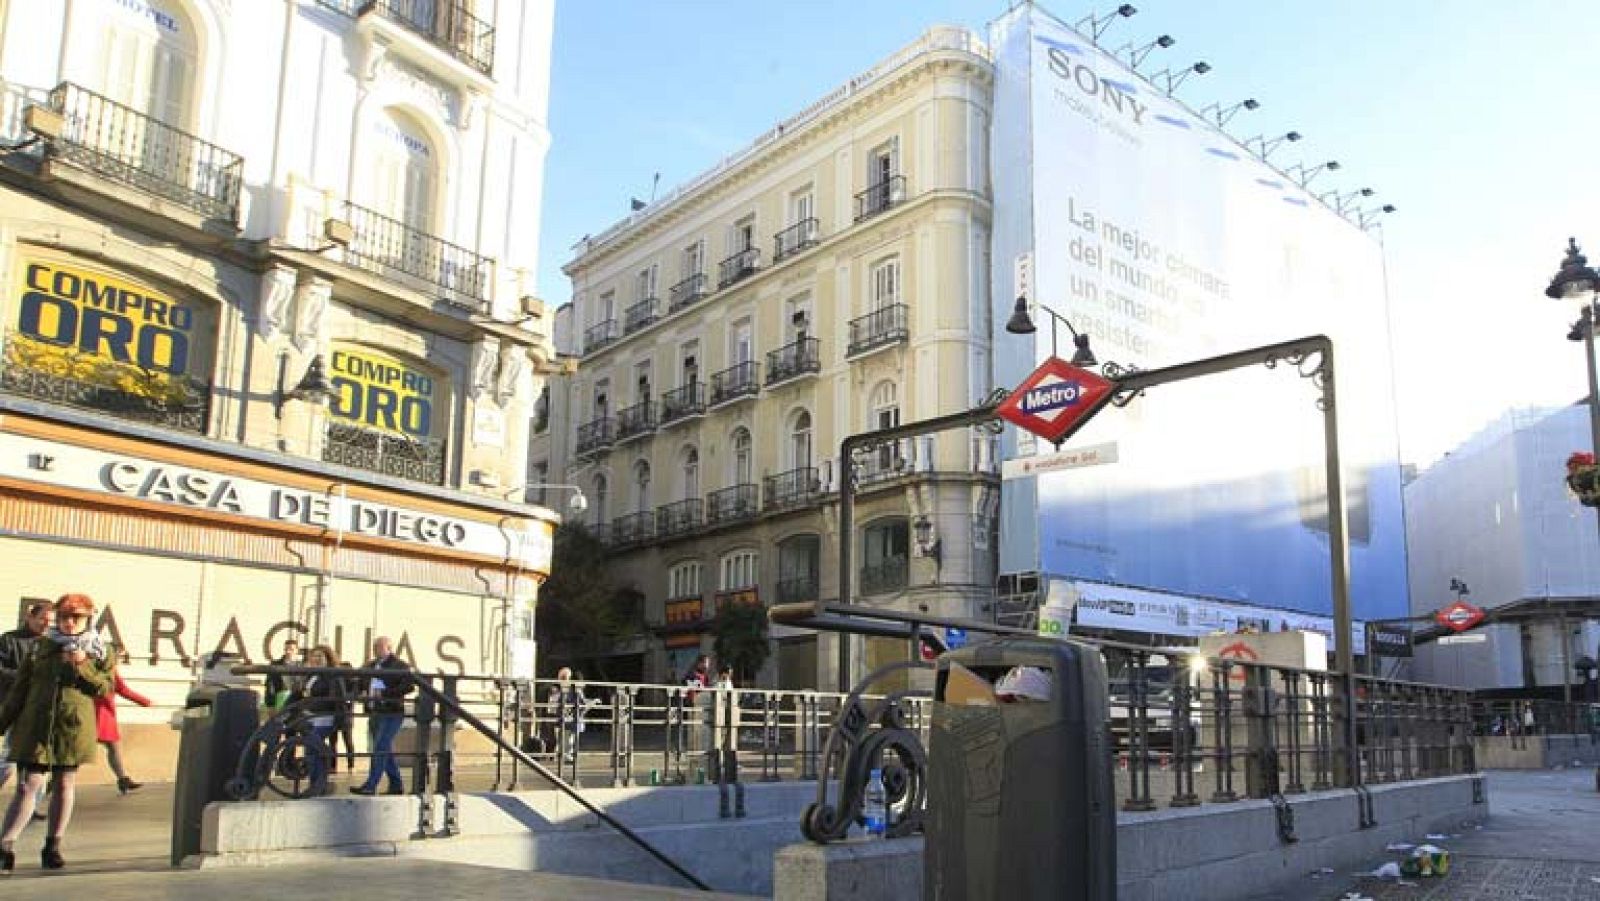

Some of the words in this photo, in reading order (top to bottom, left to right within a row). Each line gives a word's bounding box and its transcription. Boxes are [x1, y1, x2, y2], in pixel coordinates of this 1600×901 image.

[1047, 48, 1148, 125] SONY
[1068, 196, 1095, 233] La
[1102, 220, 1161, 264] mejor
[27, 264, 192, 331] COMPRO
[1069, 235, 1103, 271] del
[1109, 257, 1178, 301] mundo
[1070, 274, 1100, 302] un
[19, 291, 188, 376] ORO
[330, 376, 431, 437] ORO
[332, 351, 432, 396] COMPRO
[1026, 387, 1076, 410] Metro
[99, 462, 243, 514] CASA
[268, 488, 332, 528] DE
[351, 504, 466, 547] DIEGO
